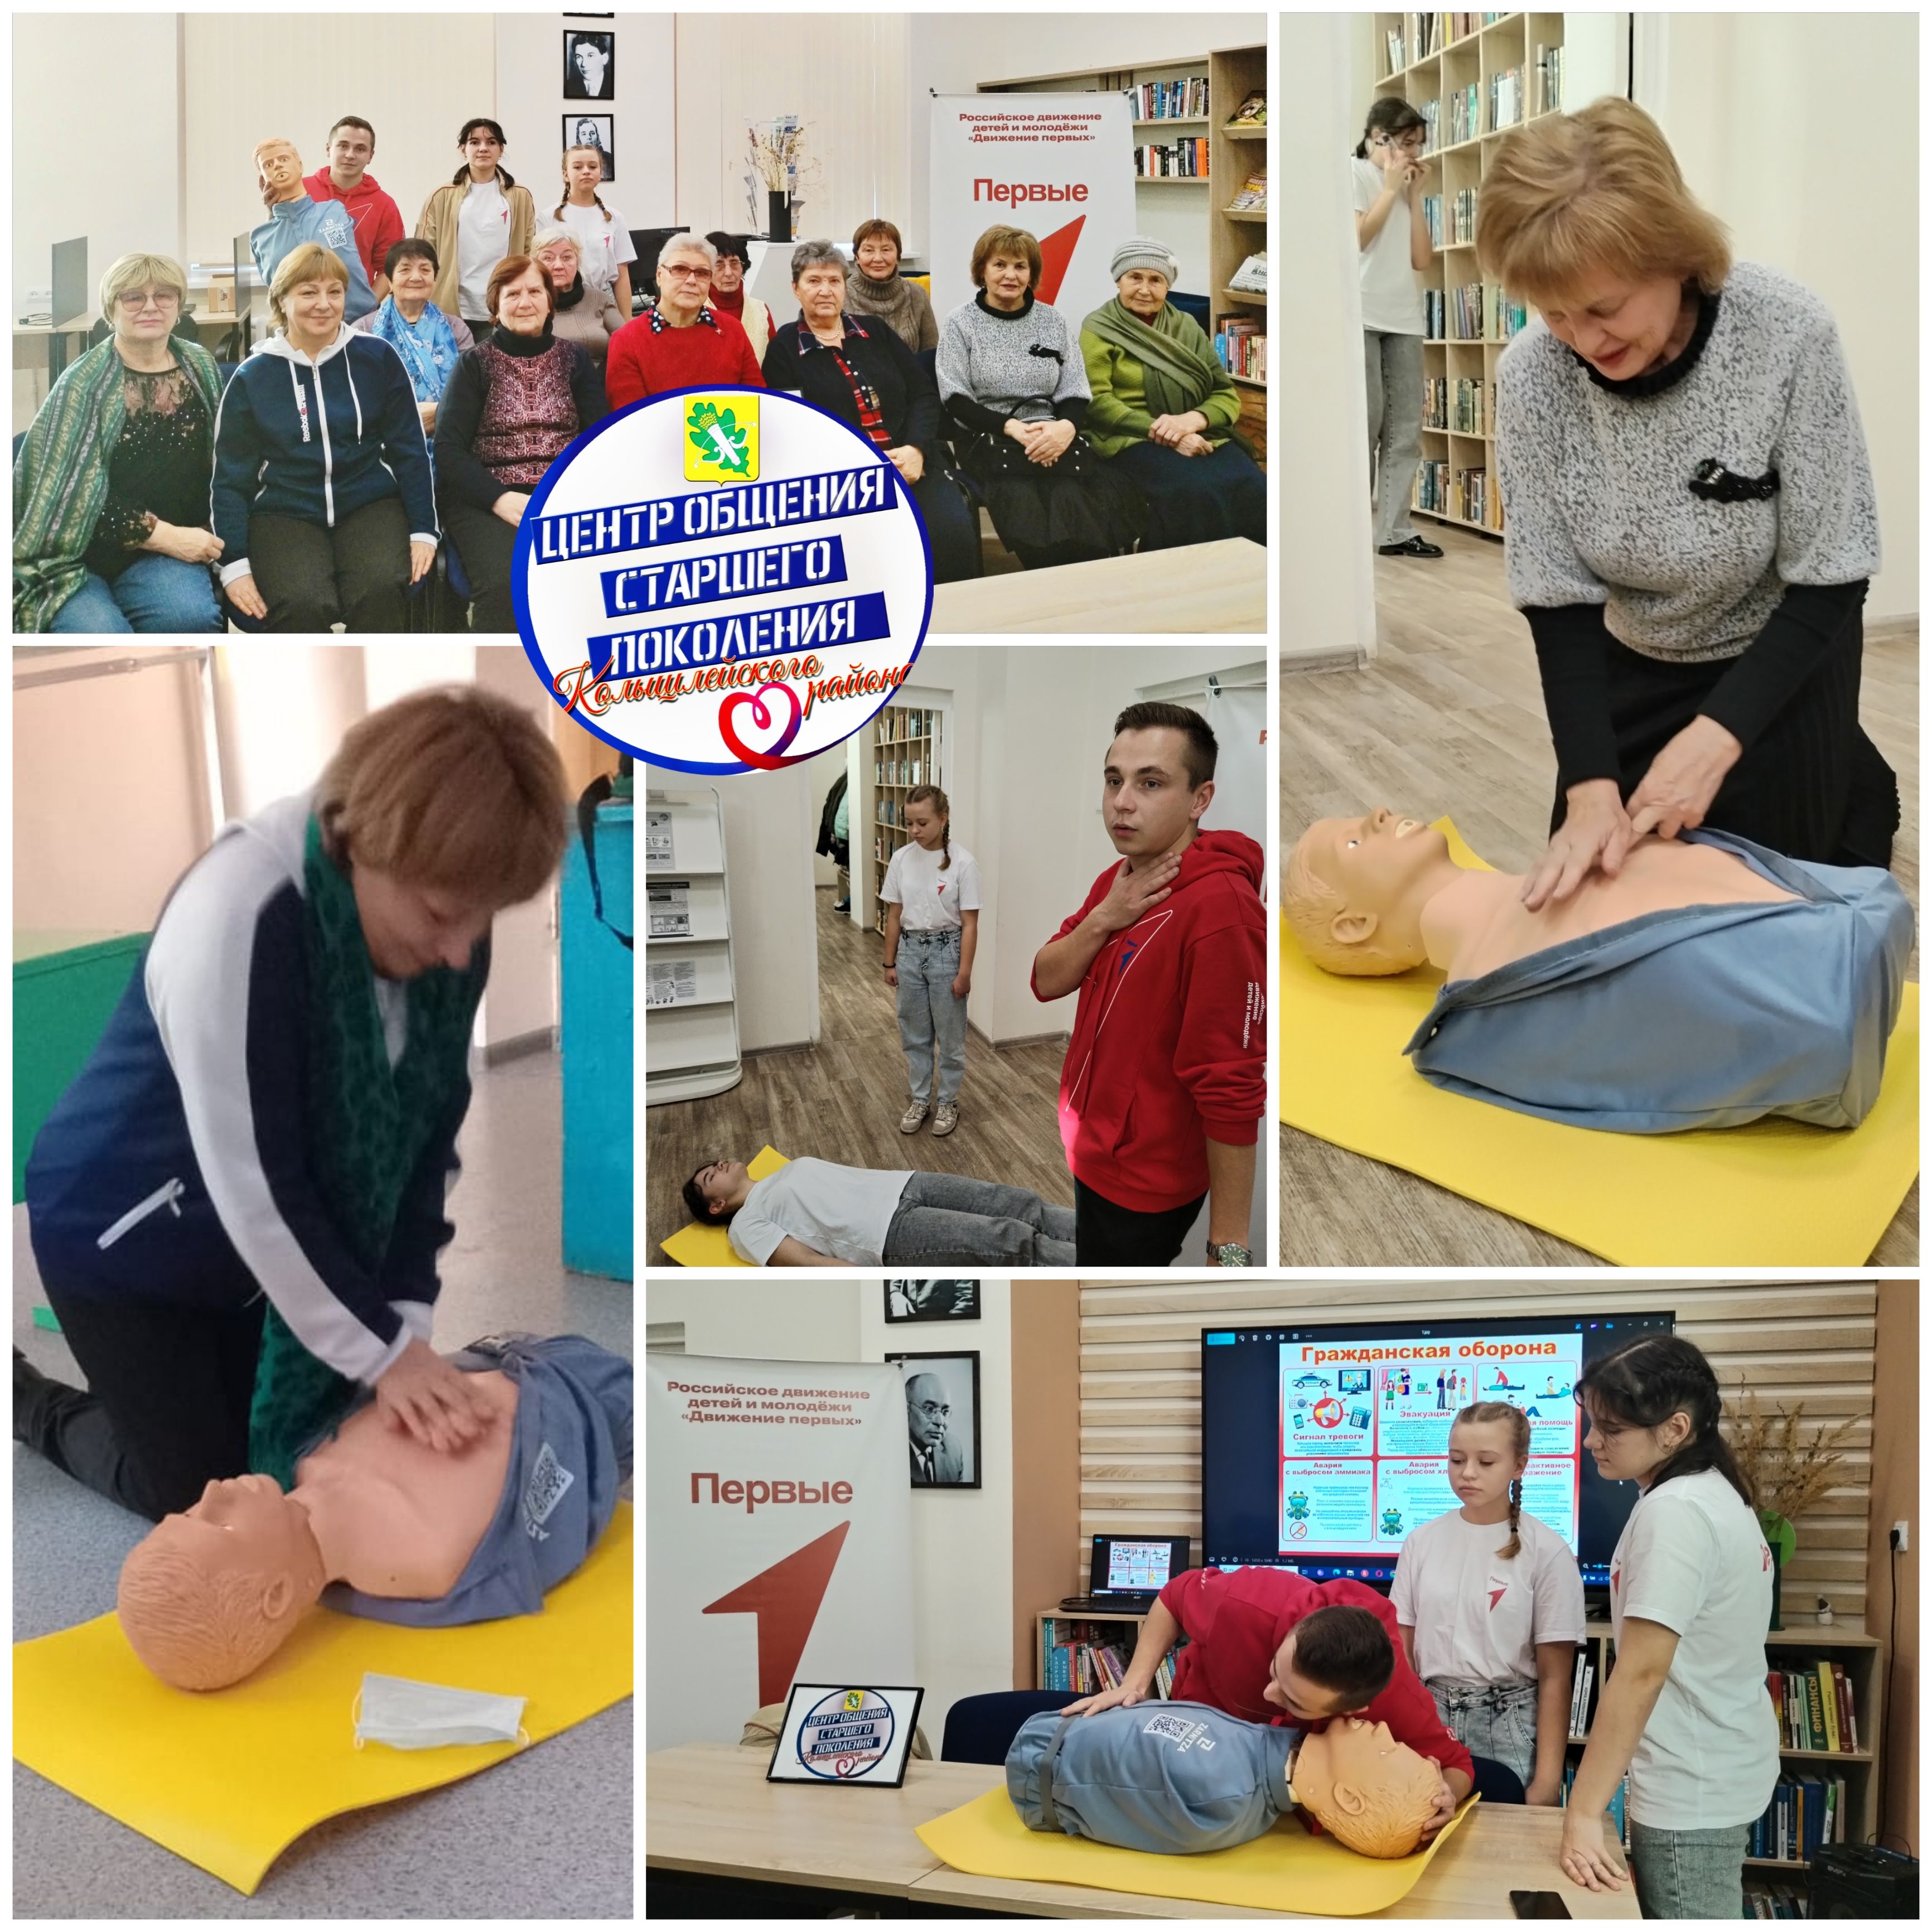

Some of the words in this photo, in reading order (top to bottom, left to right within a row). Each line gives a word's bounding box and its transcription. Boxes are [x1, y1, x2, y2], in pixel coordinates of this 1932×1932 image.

[959, 113, 1035, 122] Российское
[1037, 113, 1102, 122] движение
[972, 123, 1009, 133] детей
[1022, 123, 1088, 132] молодёжи
[968, 134, 1039, 143] «Движение
[973, 179, 1088, 209] Первые
[300, 413, 311, 442] Reebok
[1302, 1346, 1451, 1365] Гражданская
[1458, 1341, 1557, 1360] оборона
[667, 1382, 778, 1396] Российское
[781, 1388, 870, 1400] движение
[688, 1398, 742, 1409] детей
[746, 1400, 756, 1409] и
[761, 1400, 852, 1412] молодёжи
[681, 1411, 785, 1423] «Движение
[789, 1414, 862, 1426] первых»
[691, 1472, 853, 1514] Первые
[1808, 1677, 1822, 1732] ФИНАНСЫ
[808, 1713, 839, 1727] ЦЕНТР
[840, 1708, 888, 1722] ОБЩЕНИЯ
[820, 1724, 871, 1739] СТАРШЕГО
[1176, 1723, 1209, 1752] ZARNITZA
[815, 1737, 873, 1754] ПОКОЛЕНИЯ
